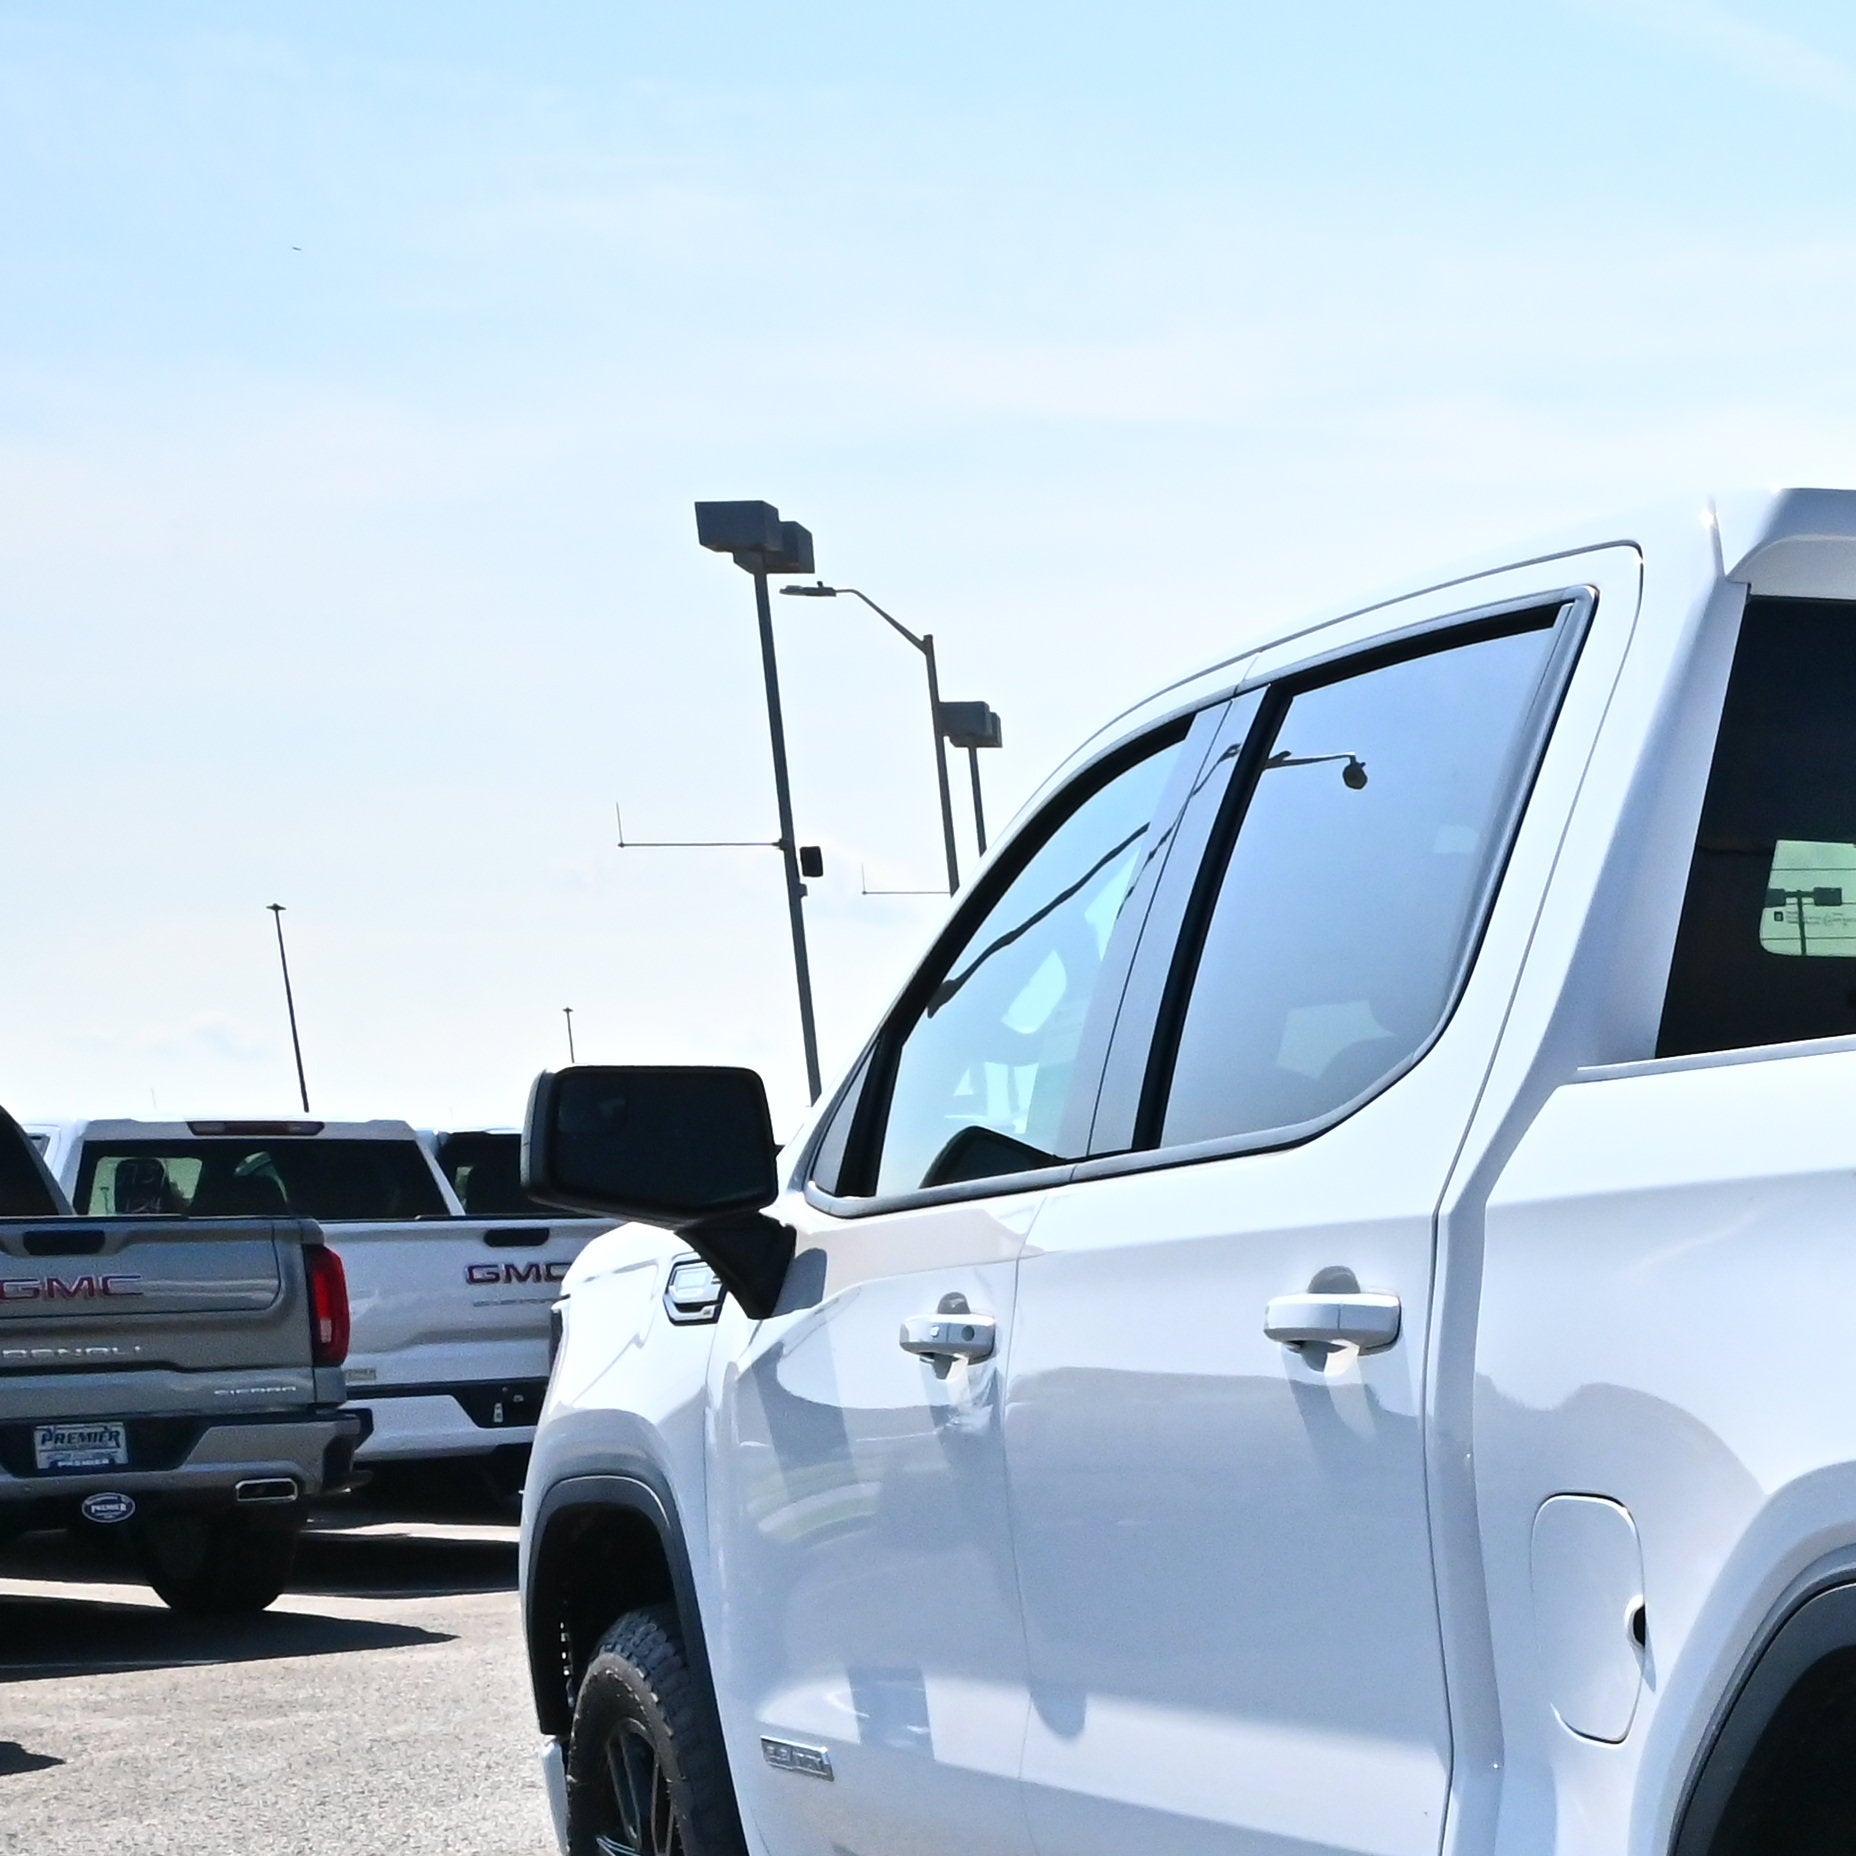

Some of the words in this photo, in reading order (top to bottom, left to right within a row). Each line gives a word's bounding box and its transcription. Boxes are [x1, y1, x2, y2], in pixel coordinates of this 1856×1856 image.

[465, 1261, 572, 1286] GMC
[0, 1274, 144, 1301] GMC
[40, 1425, 121, 1449] PREMIER
